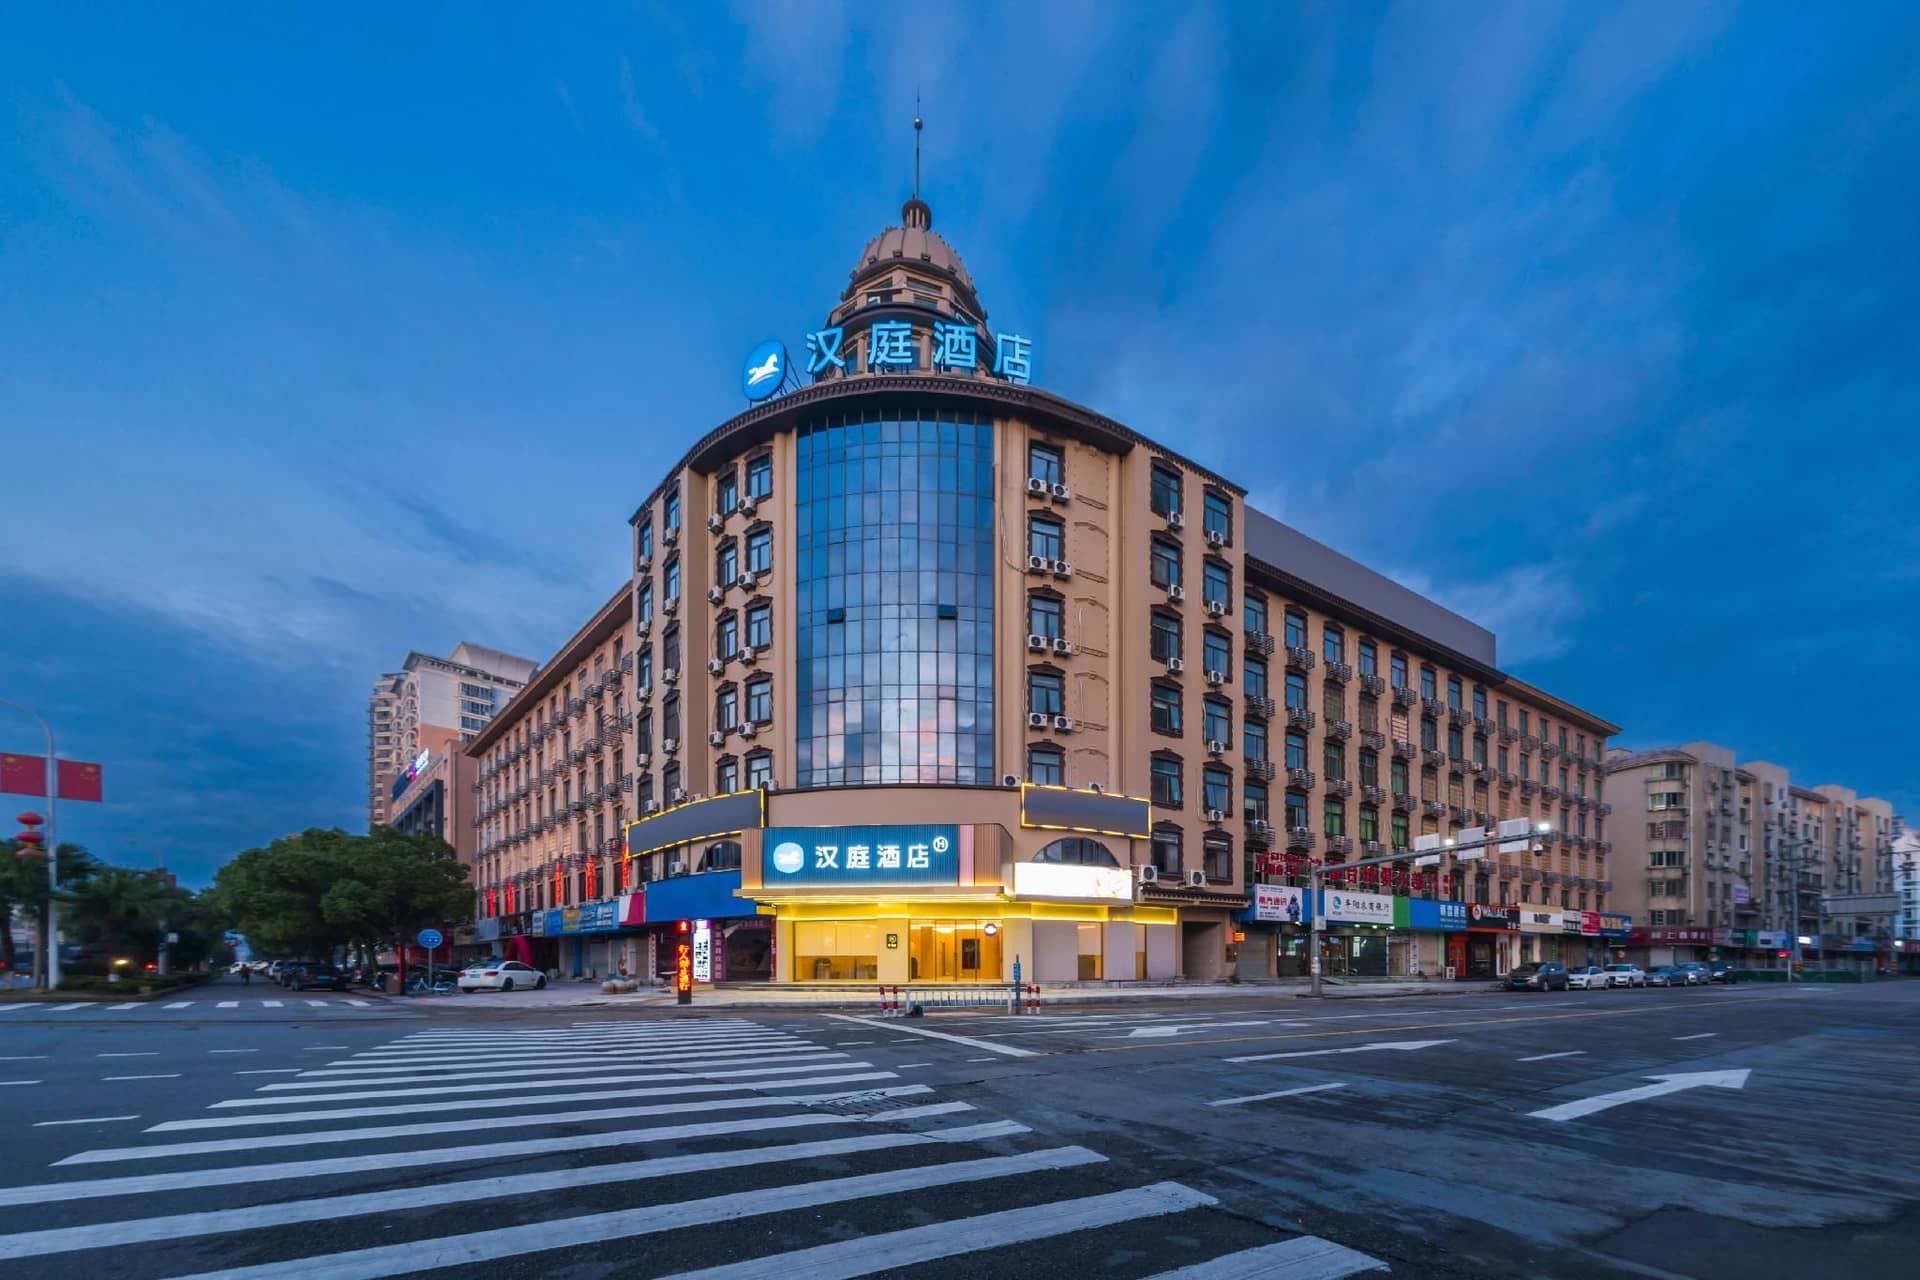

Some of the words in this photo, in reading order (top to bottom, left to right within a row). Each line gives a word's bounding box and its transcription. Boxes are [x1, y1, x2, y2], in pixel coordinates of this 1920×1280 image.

[806, 320, 1033, 385] 汉庭酒店
[815, 845, 929, 868] 汉庭酒店
[1482, 905, 1508, 919] WALLACE
